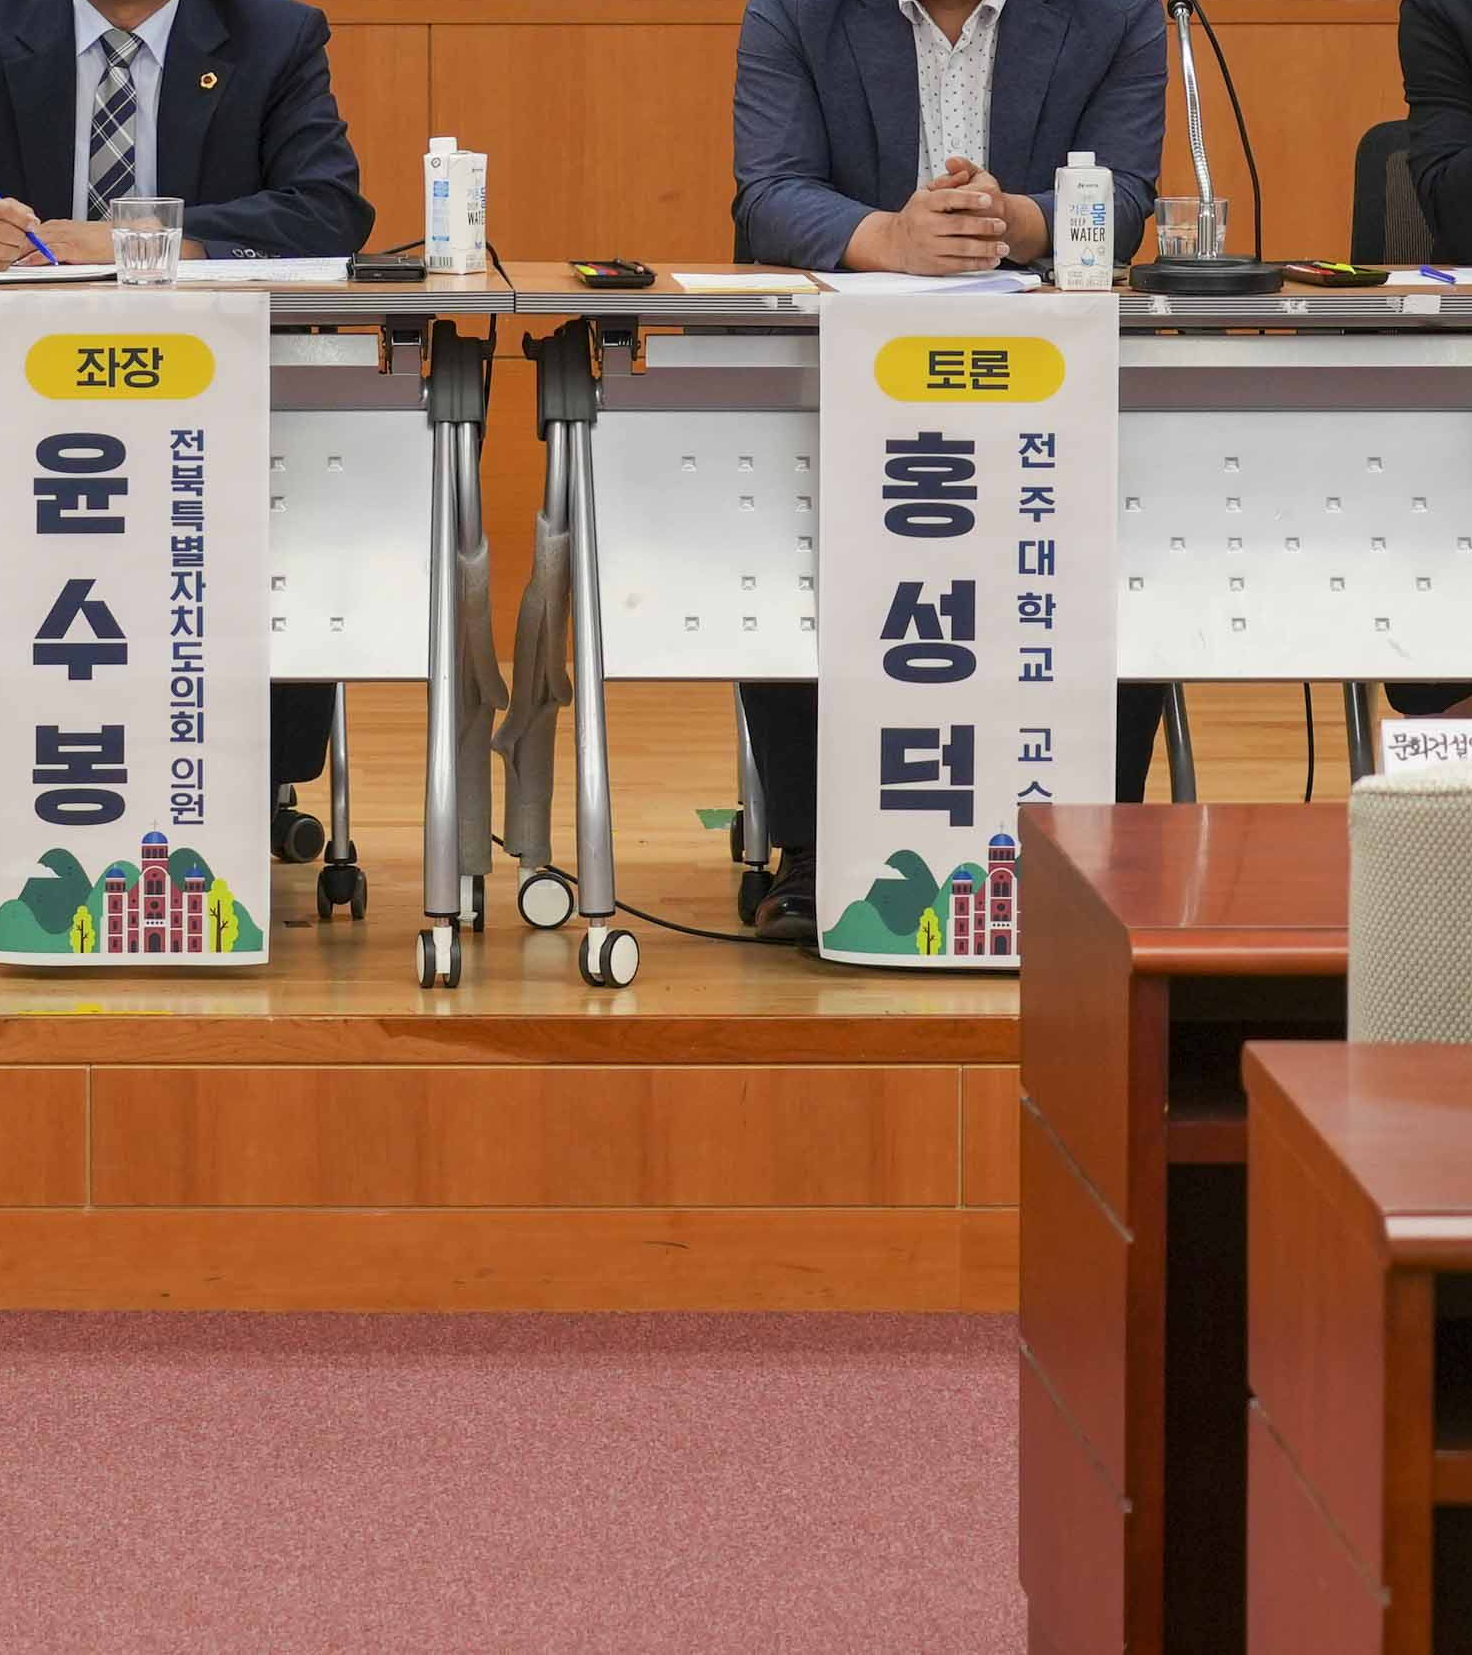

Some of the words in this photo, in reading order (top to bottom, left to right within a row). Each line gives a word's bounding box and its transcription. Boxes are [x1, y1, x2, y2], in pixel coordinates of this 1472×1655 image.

[1070, 228, 1105, 242] WATER
[77, 348, 163, 388] 좌장
[927, 351, 1010, 390] 토론
[33, 433, 128, 825] 윤수봉
[170, 430, 206, 743] 전북특별자치도의회
[880, 432, 977, 827] 홍성덕
[1018, 433, 1056, 681] 전주대학교
[170, 759, 203, 824] 의원
